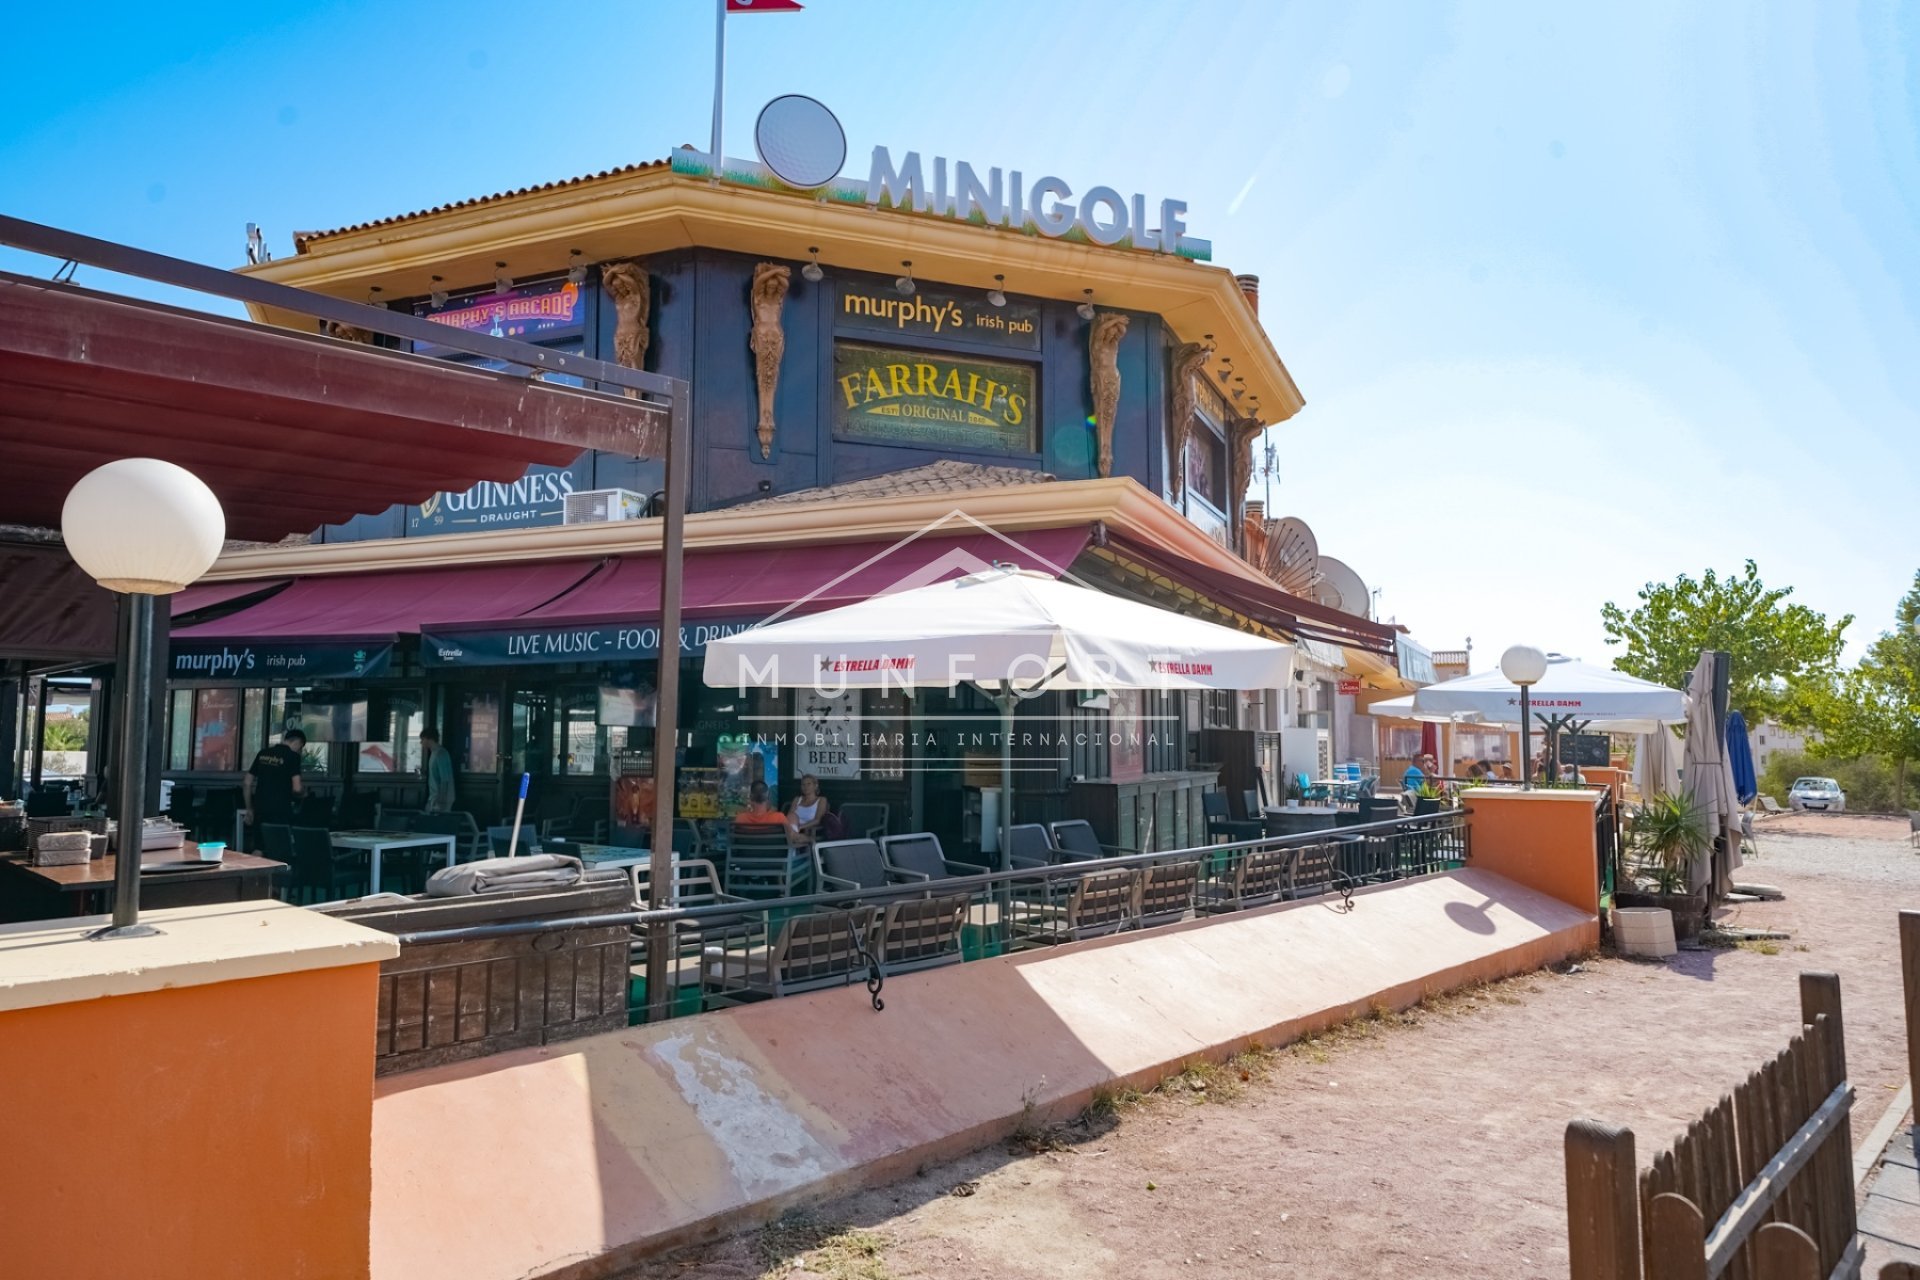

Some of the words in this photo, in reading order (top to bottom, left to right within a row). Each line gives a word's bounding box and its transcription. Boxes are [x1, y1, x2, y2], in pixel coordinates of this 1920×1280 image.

[866, 145, 1187, 253] MINIGOLF
[509, 294, 571, 317] ARCADE
[845, 294, 963, 333] murphy's
[976, 313, 1004, 329] irish
[1009, 319, 1033, 334] pub
[837, 363, 1027, 426] FARRAH'S
[902, 403, 967, 422] ORIGINAL
[411, 518, 420, 528] 17
[480, 510, 538, 523] DRAUGHT
[508, 634, 540, 655] LIVE
[544, 631, 600, 653] MUSIC
[617, 628, 660, 650] FOO
[176, 646, 255, 676] murphy's
[266, 654, 286, 667] irish
[287, 654, 306, 670] pub
[833, 659, 880, 672] ESTRELLA
[882, 657, 916, 670] DAMM
[1157, 661, 1191, 675] ESTRELLA
[1191, 663, 1213, 676] DAMM
[808, 751, 848, 765] BEER
[818, 766, 838, 775] TIME
